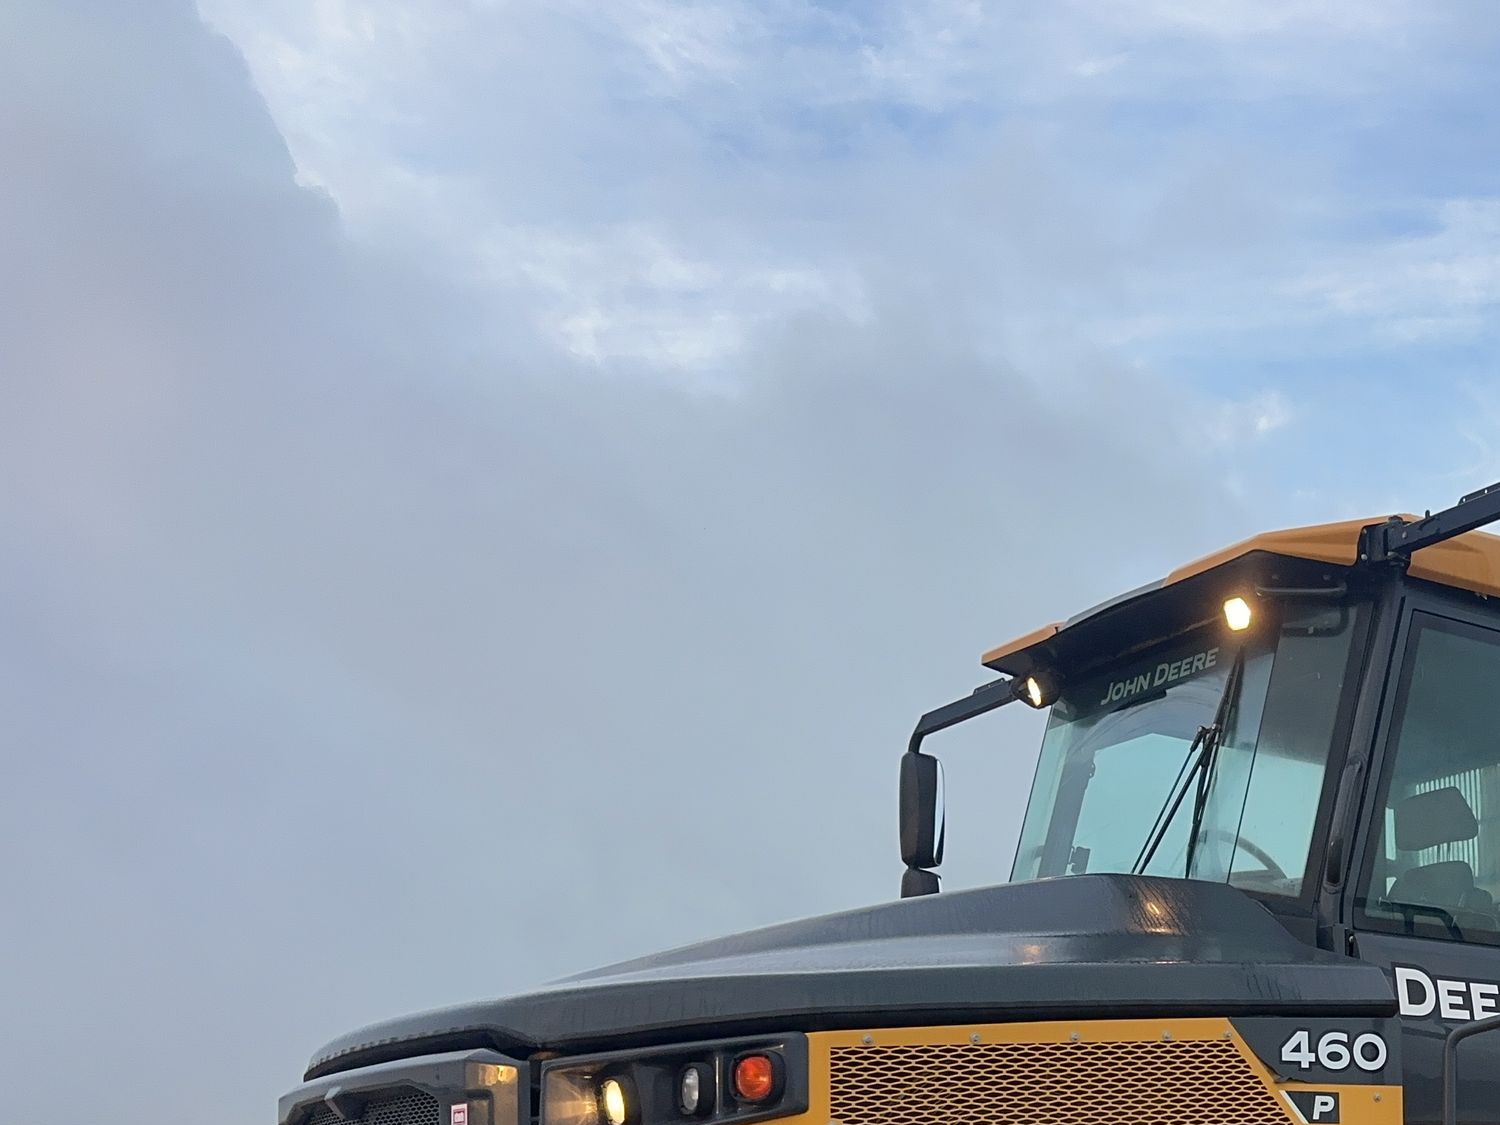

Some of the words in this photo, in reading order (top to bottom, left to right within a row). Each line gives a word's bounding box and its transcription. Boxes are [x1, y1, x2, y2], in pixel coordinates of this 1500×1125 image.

[1101, 672, 1151, 706] JOHN
[1153, 648, 1219, 687] DEERE
[1281, 1030, 1387, 1071] 460
[1312, 1095, 1335, 1121] P
